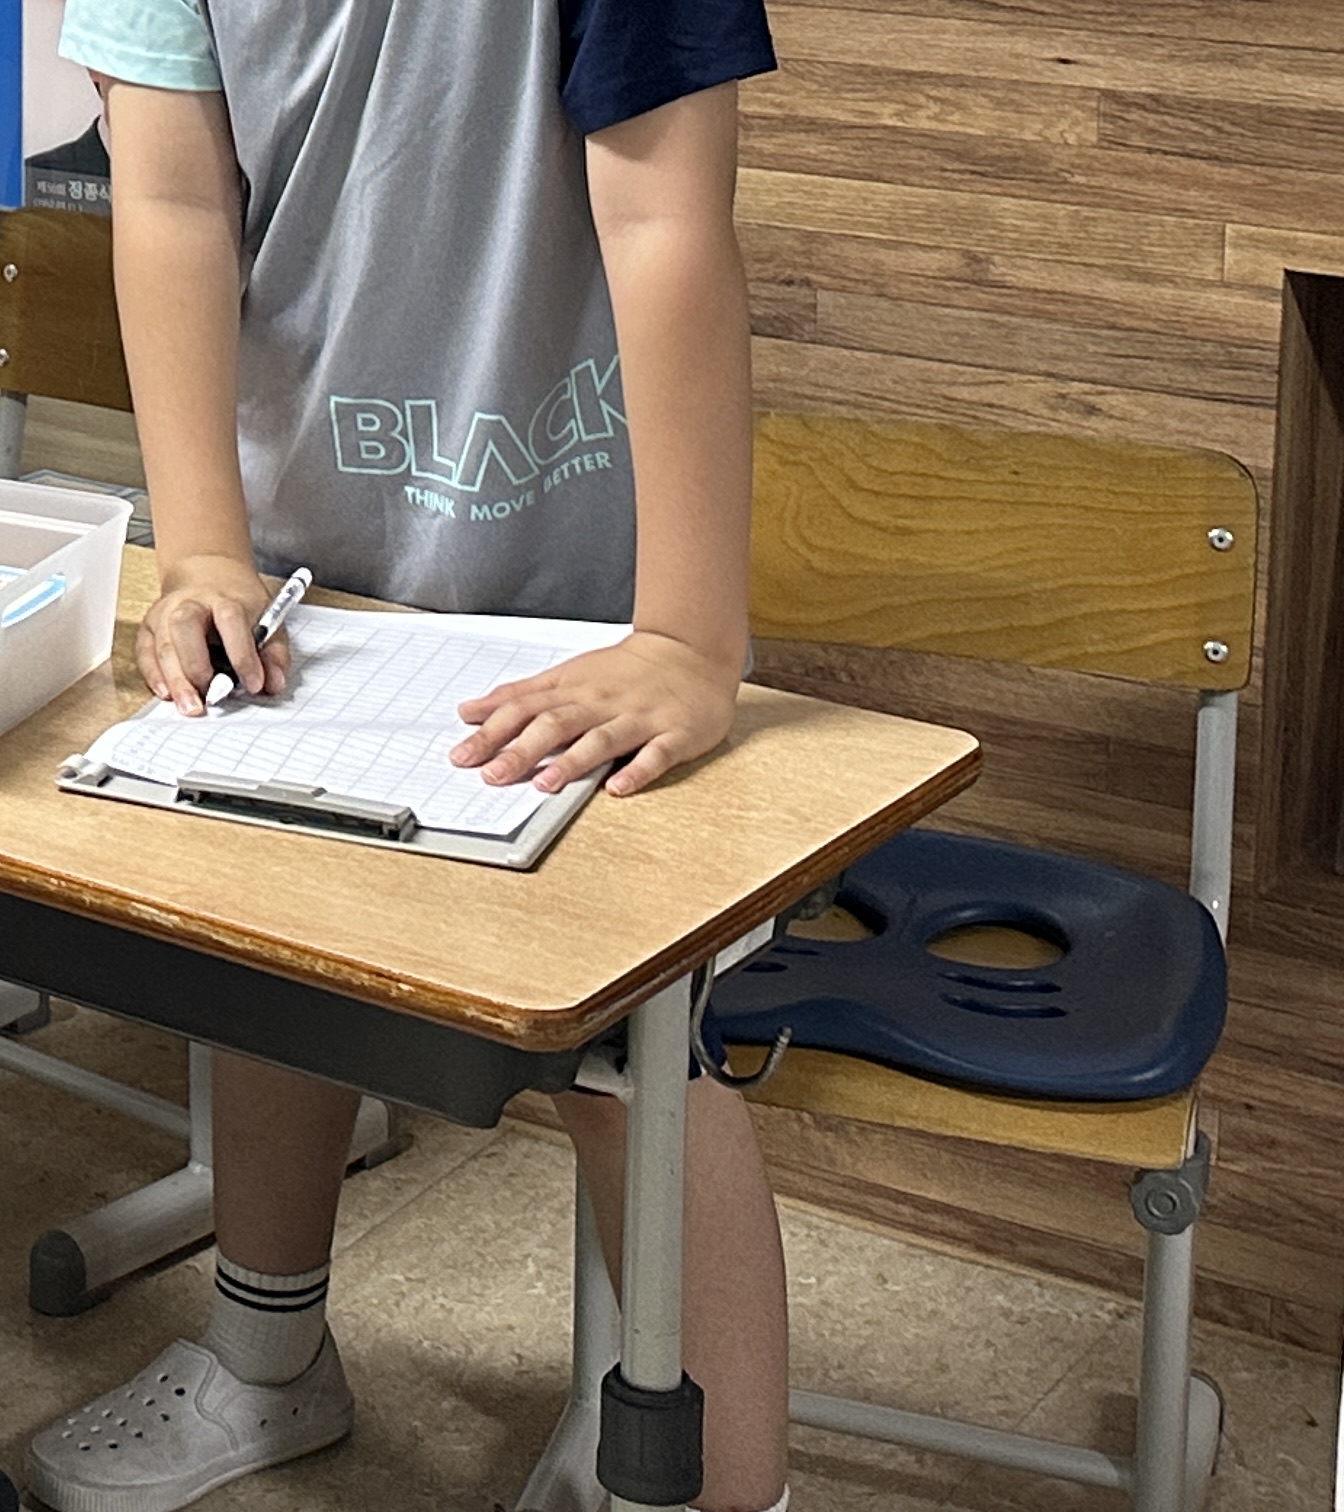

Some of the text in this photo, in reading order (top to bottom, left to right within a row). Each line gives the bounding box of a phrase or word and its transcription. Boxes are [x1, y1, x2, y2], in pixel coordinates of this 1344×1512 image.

[329, 354, 631, 492] BLACK
[403, 450, 612, 522] THINK MOVE BETTER
